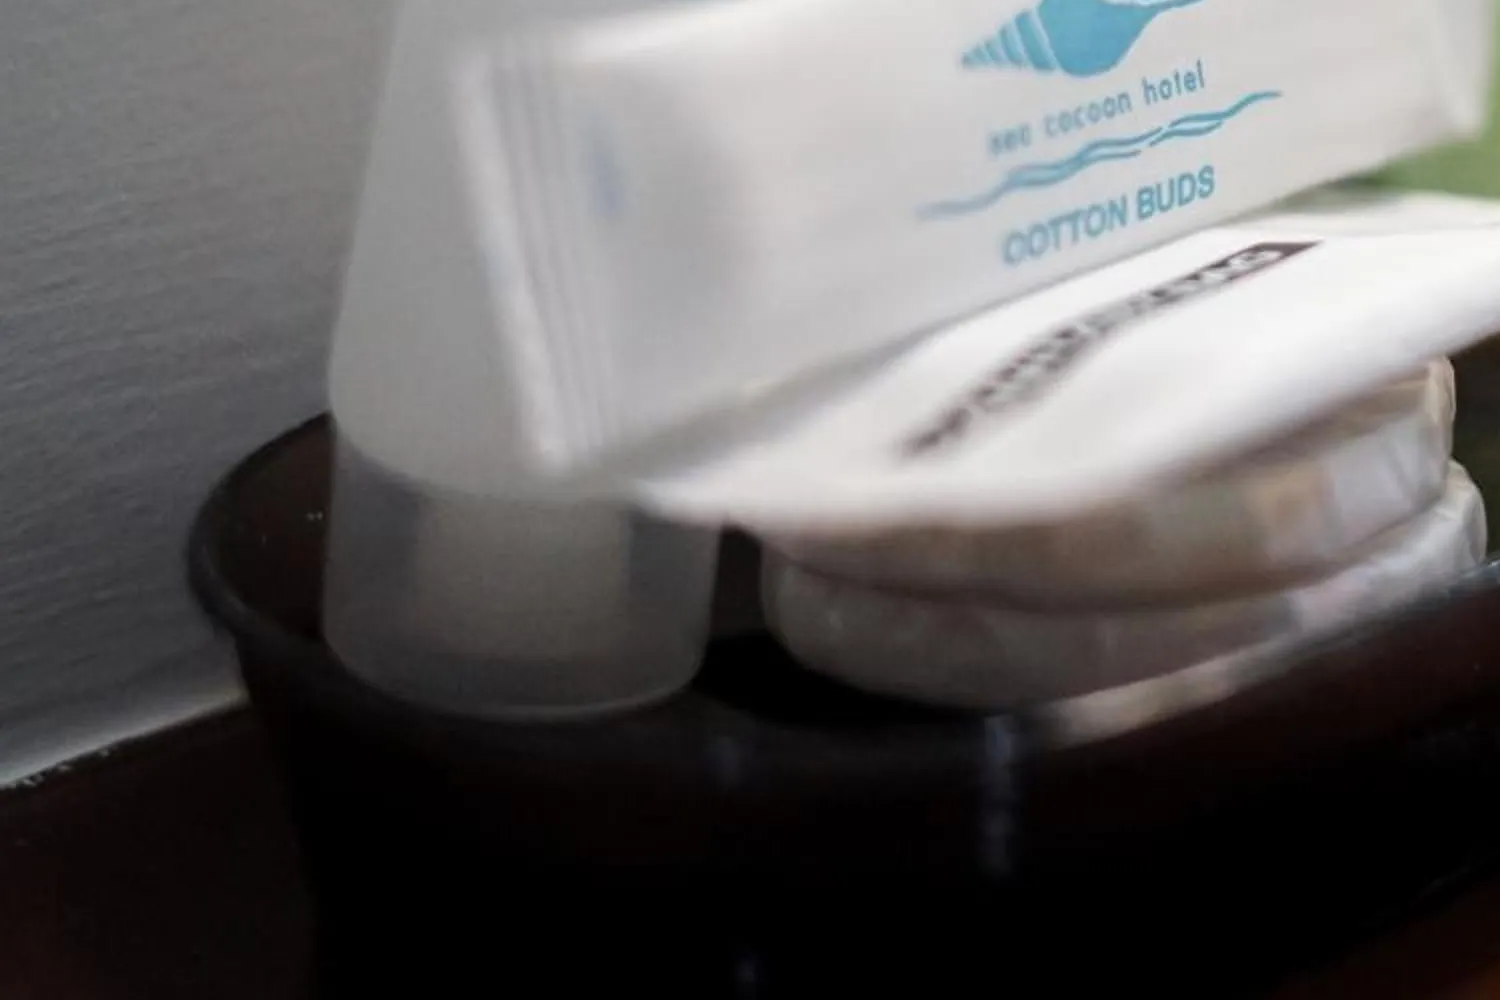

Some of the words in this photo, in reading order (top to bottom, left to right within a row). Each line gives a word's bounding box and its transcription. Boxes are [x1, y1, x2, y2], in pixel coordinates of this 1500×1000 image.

[1044, 91, 1133, 138] cocoon
[1142, 57, 1206, 105] hotel
[1003, 195, 1128, 266] COTTON
[1137, 164, 1216, 222] BUDS
